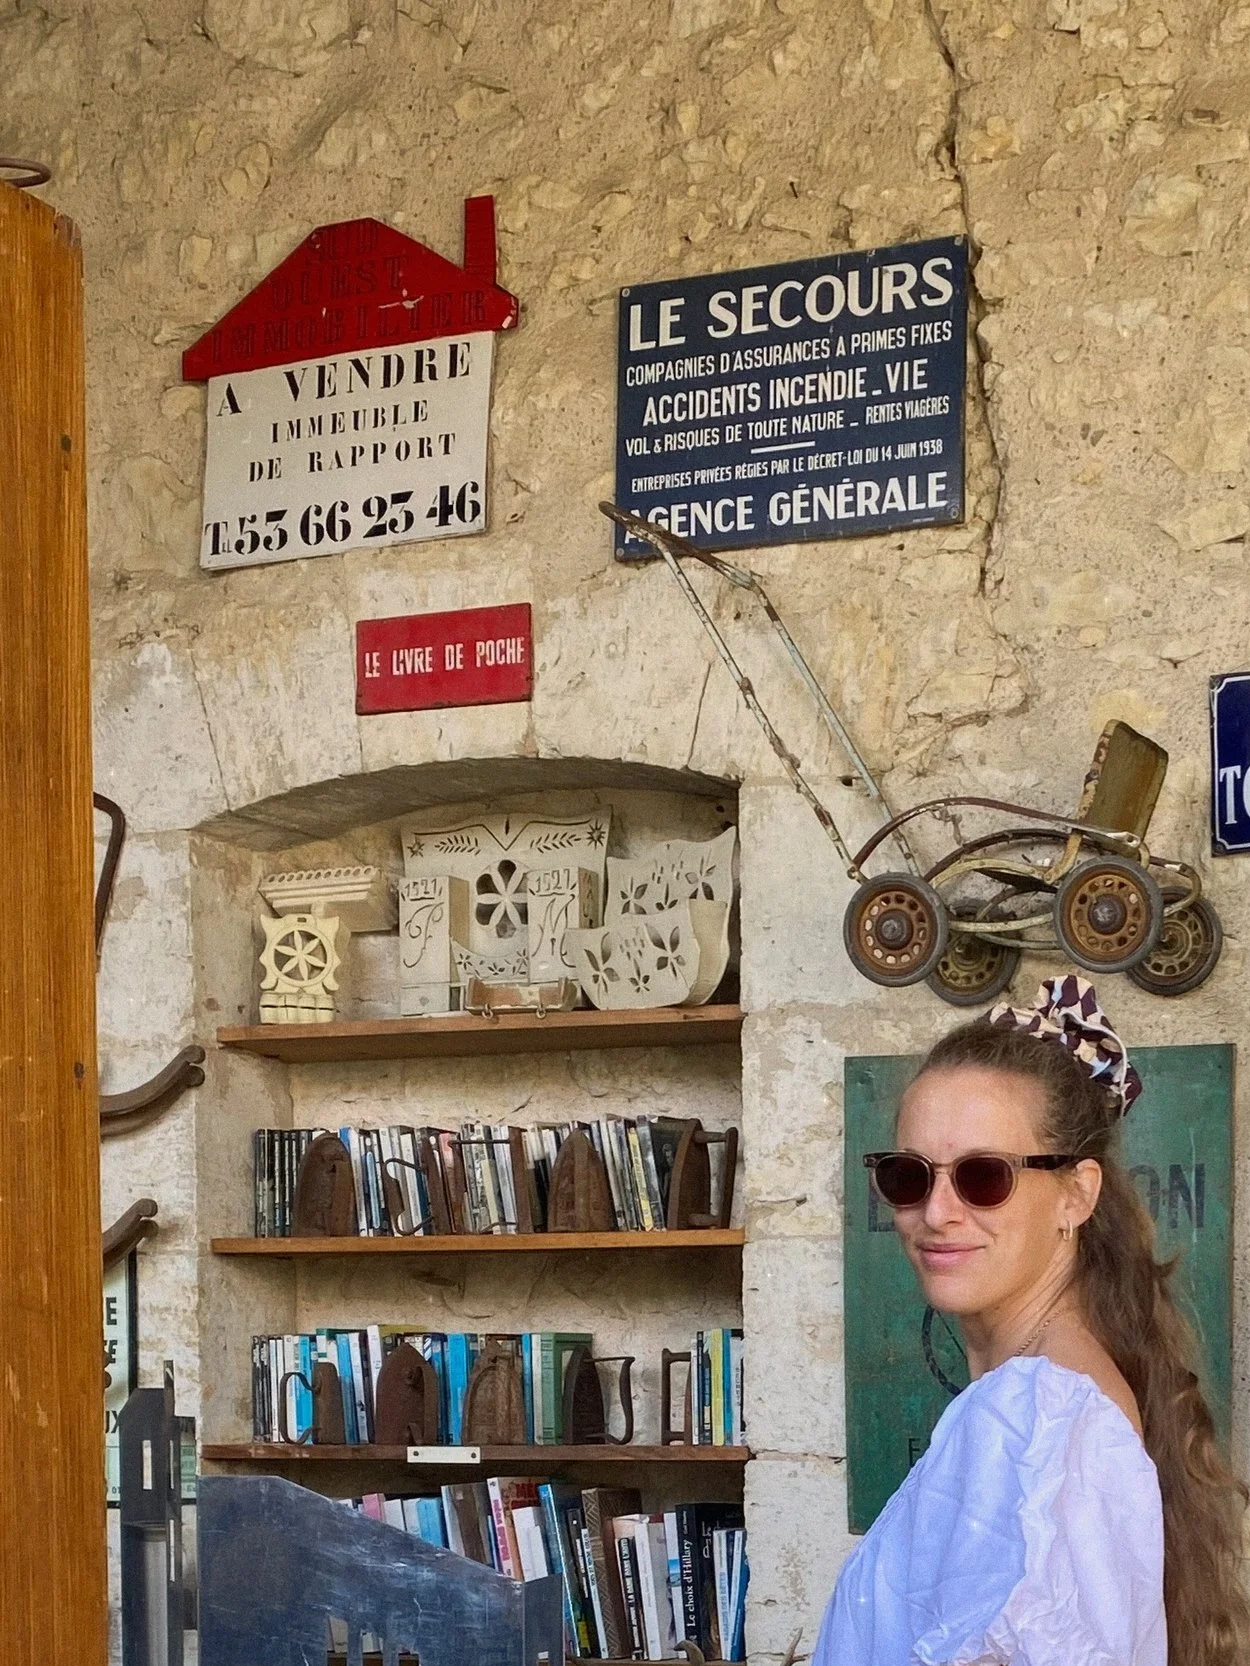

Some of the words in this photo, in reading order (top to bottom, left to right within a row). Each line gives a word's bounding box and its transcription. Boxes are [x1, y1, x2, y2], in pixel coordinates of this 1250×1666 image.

[270, 256, 411, 313] OUEST
[630, 298, 686, 351] LE
[707, 257, 953, 339] SECOURS
[211, 289, 488, 365] IMMOBILIER
[626, 354, 716, 388] COMPAGNIES
[720, 336, 831, 376] D'ASSURANCES
[836, 336, 847, 358] A
[851, 326, 906, 355] PRIMES
[911, 320, 953, 346] FIXES
[216, 382, 243, 417] A
[283, 342, 471, 402] VENDRE
[642, 382, 761, 427] ACCIDENTS
[769, 365, 868, 412] INCENDIE
[884, 358, 929, 392] VIE
[271, 400, 428, 444] IMMEUBLE
[626, 435, 650, 457] VOL
[654, 437, 663, 454] &
[664, 427, 720, 453] RISQUES
[725, 425, 743, 444] DE
[747, 418, 788, 442] TOUTE
[792, 410, 845, 436] NATURE
[865, 402, 903, 425] RENTES
[904, 395, 950, 421] VIAGÈRES
[249, 457, 283, 483] DE
[307, 432, 456, 474] RAPPORT
[631, 472, 692, 494] ENTREPRISES
[694, 466, 733, 487] PRIVÉES
[735, 460, 769, 481] RÉGIES
[771, 457, 790, 476] PAR
[793, 457, 805, 473] LE
[807, 446, 864, 471] DÉCRET-LOI
[866, 446, 879, 463] DU
[881, 445, 892, 462] 14
[894, 441, 917, 461] JUIN
[919, 438, 944, 456] 1938
[234, 508, 288, 556] 53
[300, 500, 352, 547] 66
[362, 490, 415, 539] 23
[425, 480, 482, 528] 46
[624, 495, 755, 545] AGENCE
[768, 471, 949, 527] GÉNÉRALE
[365, 652, 380, 678] LE
[392, 646, 434, 676] LIVRE
[444, 643, 464, 671] DE
[476, 636, 525, 667] POCHE
[682, 1539, 693, 1585] d'Hillary
[684, 1585, 695, 1612] choix
[686, 1614, 696, 1627] Le
